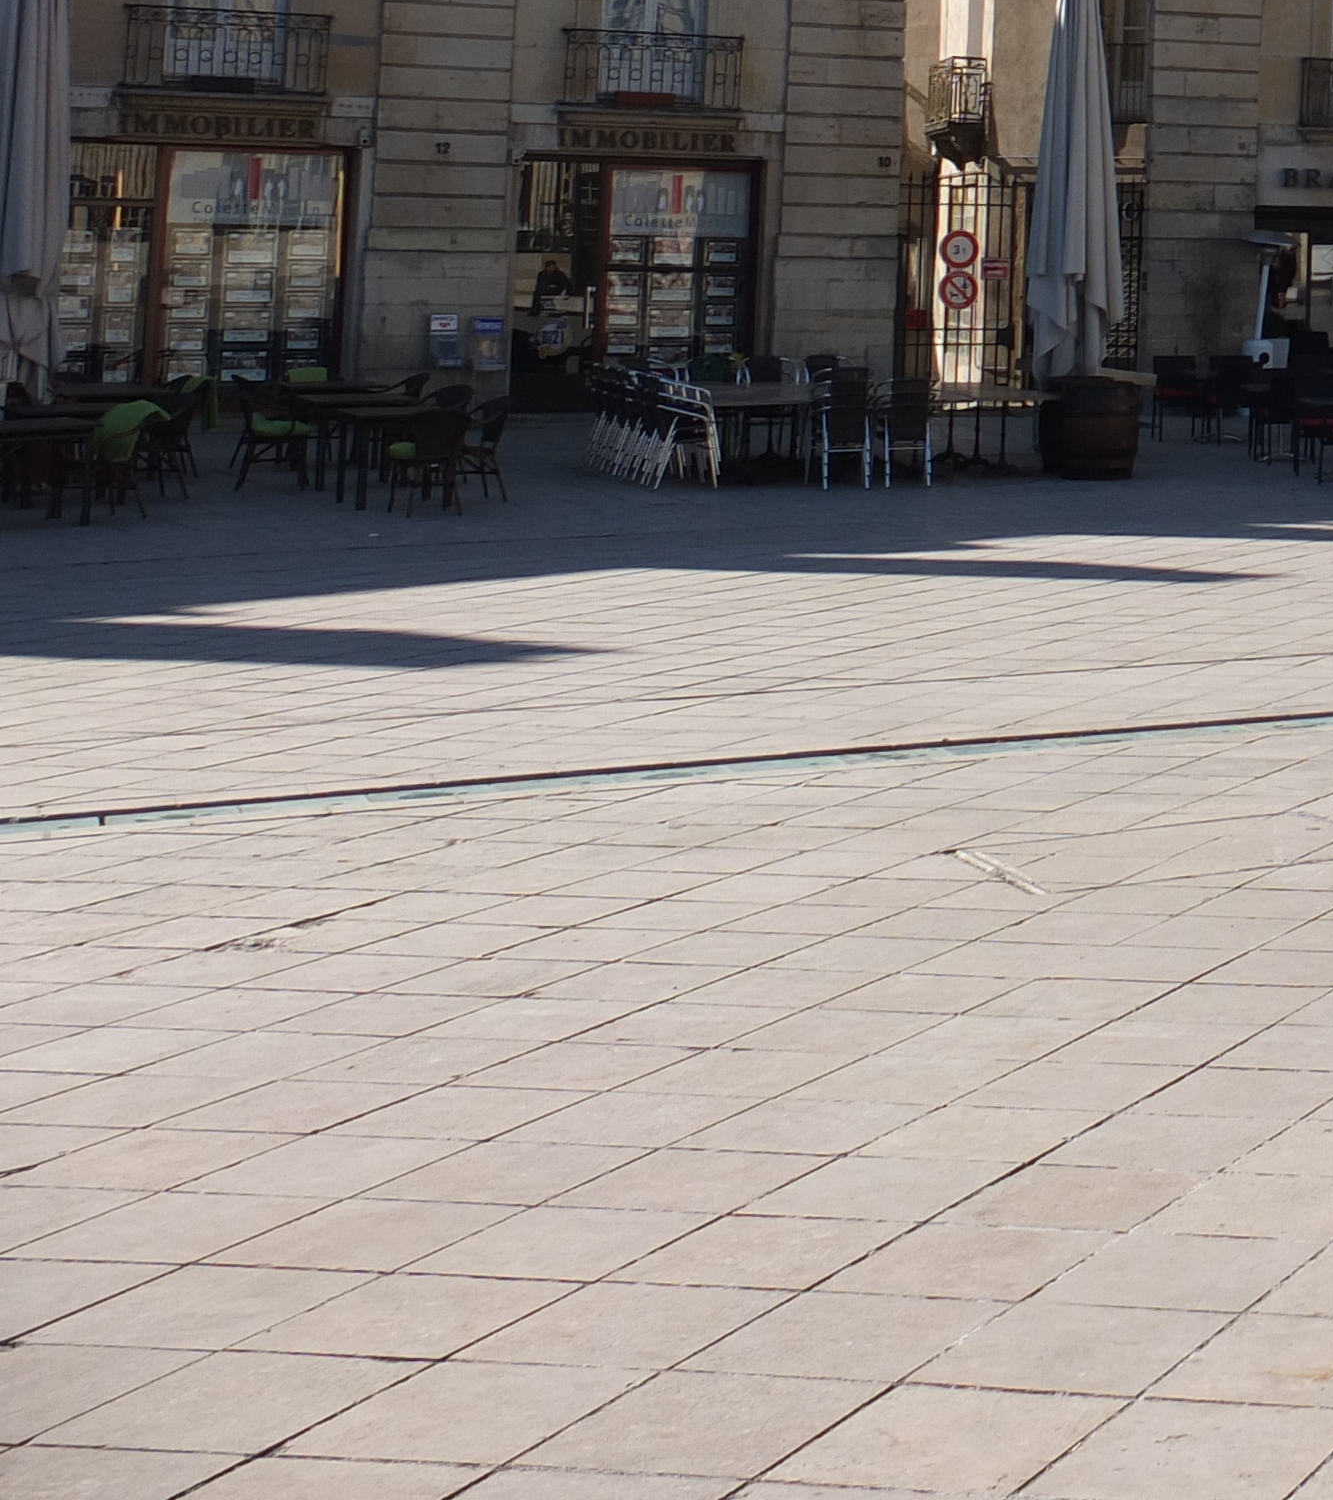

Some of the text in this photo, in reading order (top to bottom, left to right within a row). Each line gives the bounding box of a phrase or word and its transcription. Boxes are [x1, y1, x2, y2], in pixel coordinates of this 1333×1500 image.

[120, 113, 316, 139] IMMOBILIER
[435, 142, 450, 154] 12
[559, 128, 736, 152] IMMOBILIER
[878, 156, 892, 168] 10
